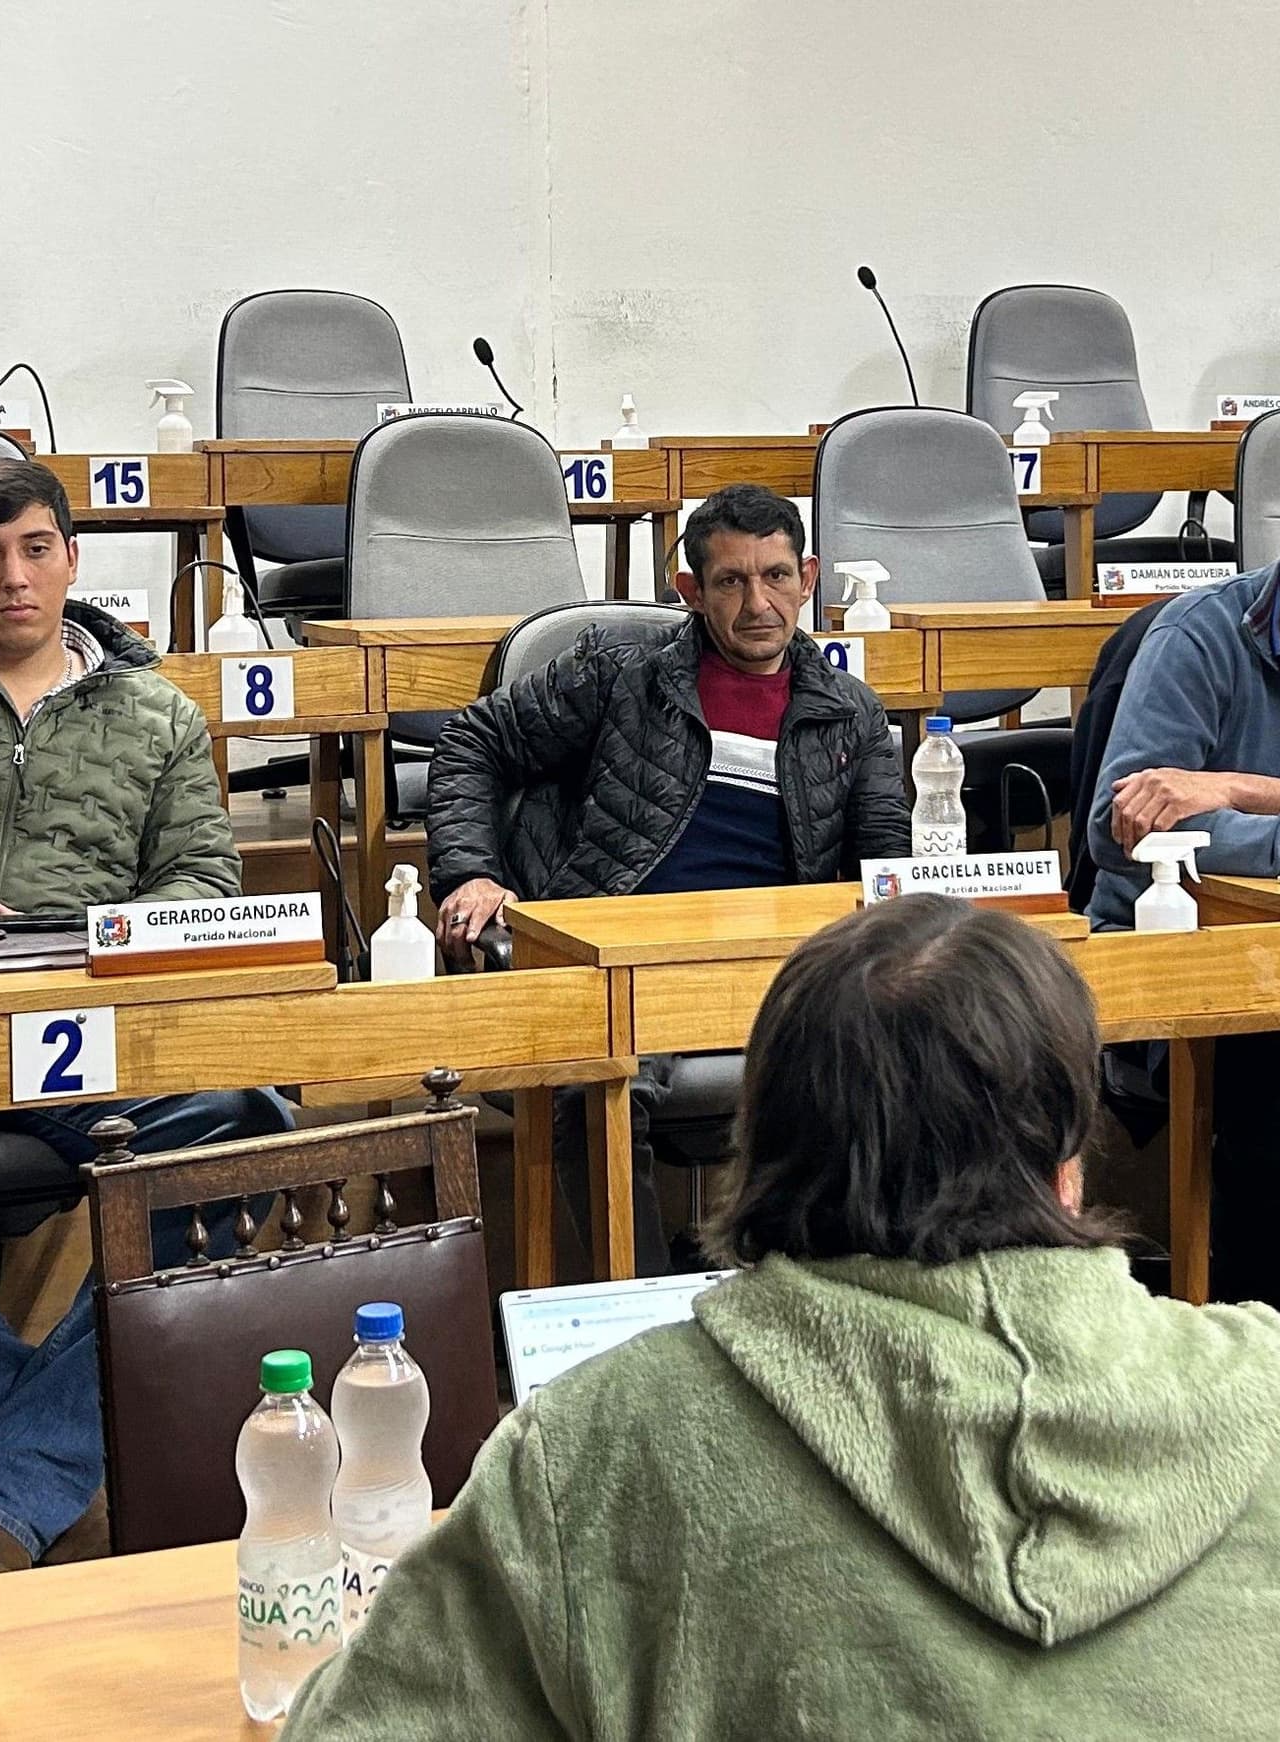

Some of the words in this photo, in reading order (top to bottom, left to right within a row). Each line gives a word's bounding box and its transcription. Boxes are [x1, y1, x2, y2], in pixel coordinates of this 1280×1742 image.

[1242, 398, 1274, 408] ANDRÉS
[94, 462, 144, 504] 15
[564, 459, 607, 499] 16
[1009, 453, 1038, 490] 7
[1130, 567, 1170, 579] DAMIÁN
[1172, 569, 1186, 579] DE
[1188, 568, 1231, 579] OLIVEIRA
[245, 664, 275, 716] 8
[911, 863, 982, 880] GRACIELA
[987, 861, 1052, 877] BENQUET
[945, 885, 979, 894] Partido
[981, 883, 1022, 892] Nacional
[147, 906, 226, 926] GERARDO
[229, 902, 311, 921] GANDARA
[184, 930, 226, 943] Partido
[228, 927, 277, 940] Nacional
[40, 1019, 83, 1093] 2
